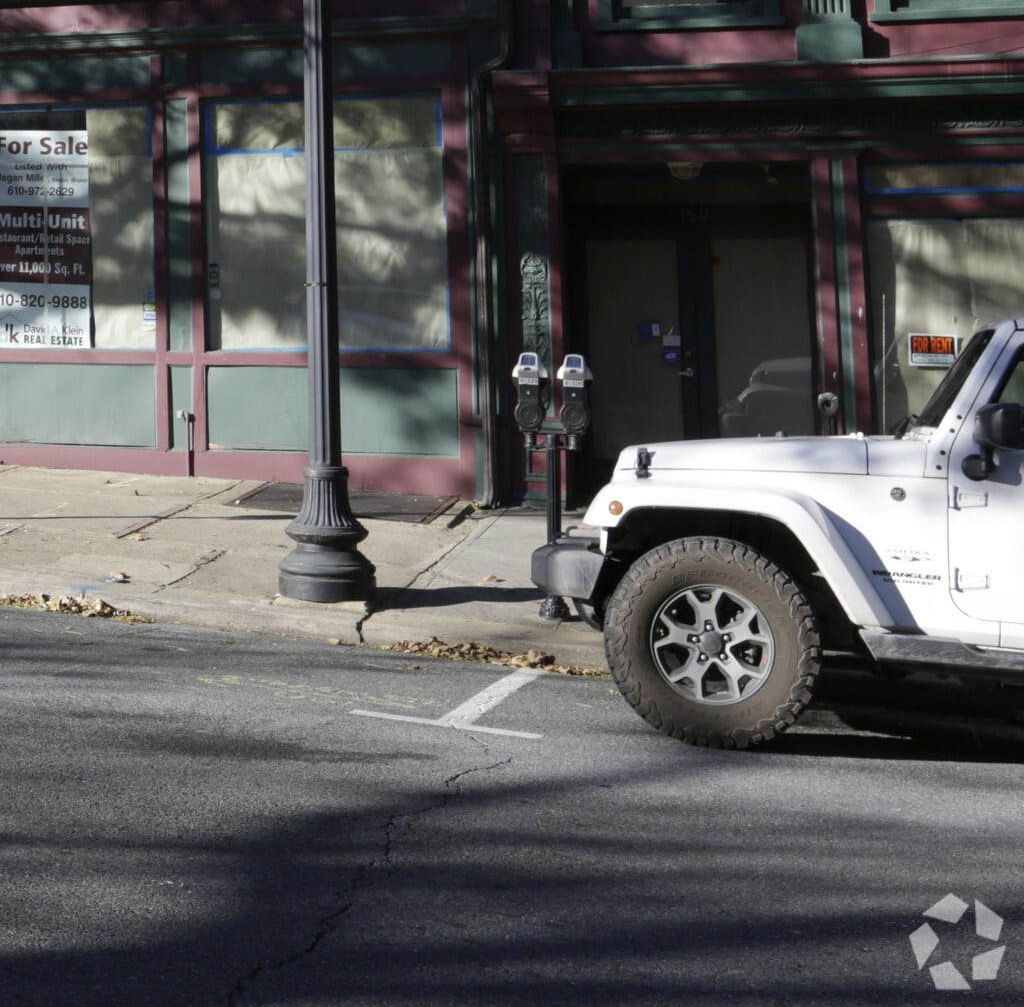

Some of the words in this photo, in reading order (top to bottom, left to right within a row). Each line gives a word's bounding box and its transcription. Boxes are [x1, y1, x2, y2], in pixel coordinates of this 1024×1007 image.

[40, 136, 88, 155] Sale
[15, 163, 42, 171] Listed
[15, 245, 65, 257] Apartmnts
[51, 335, 84, 346] ESTATE
[912, 337, 929, 353] FOR
[930, 337, 953, 354] RENT
[872, 570, 942, 582] WRANGLER
